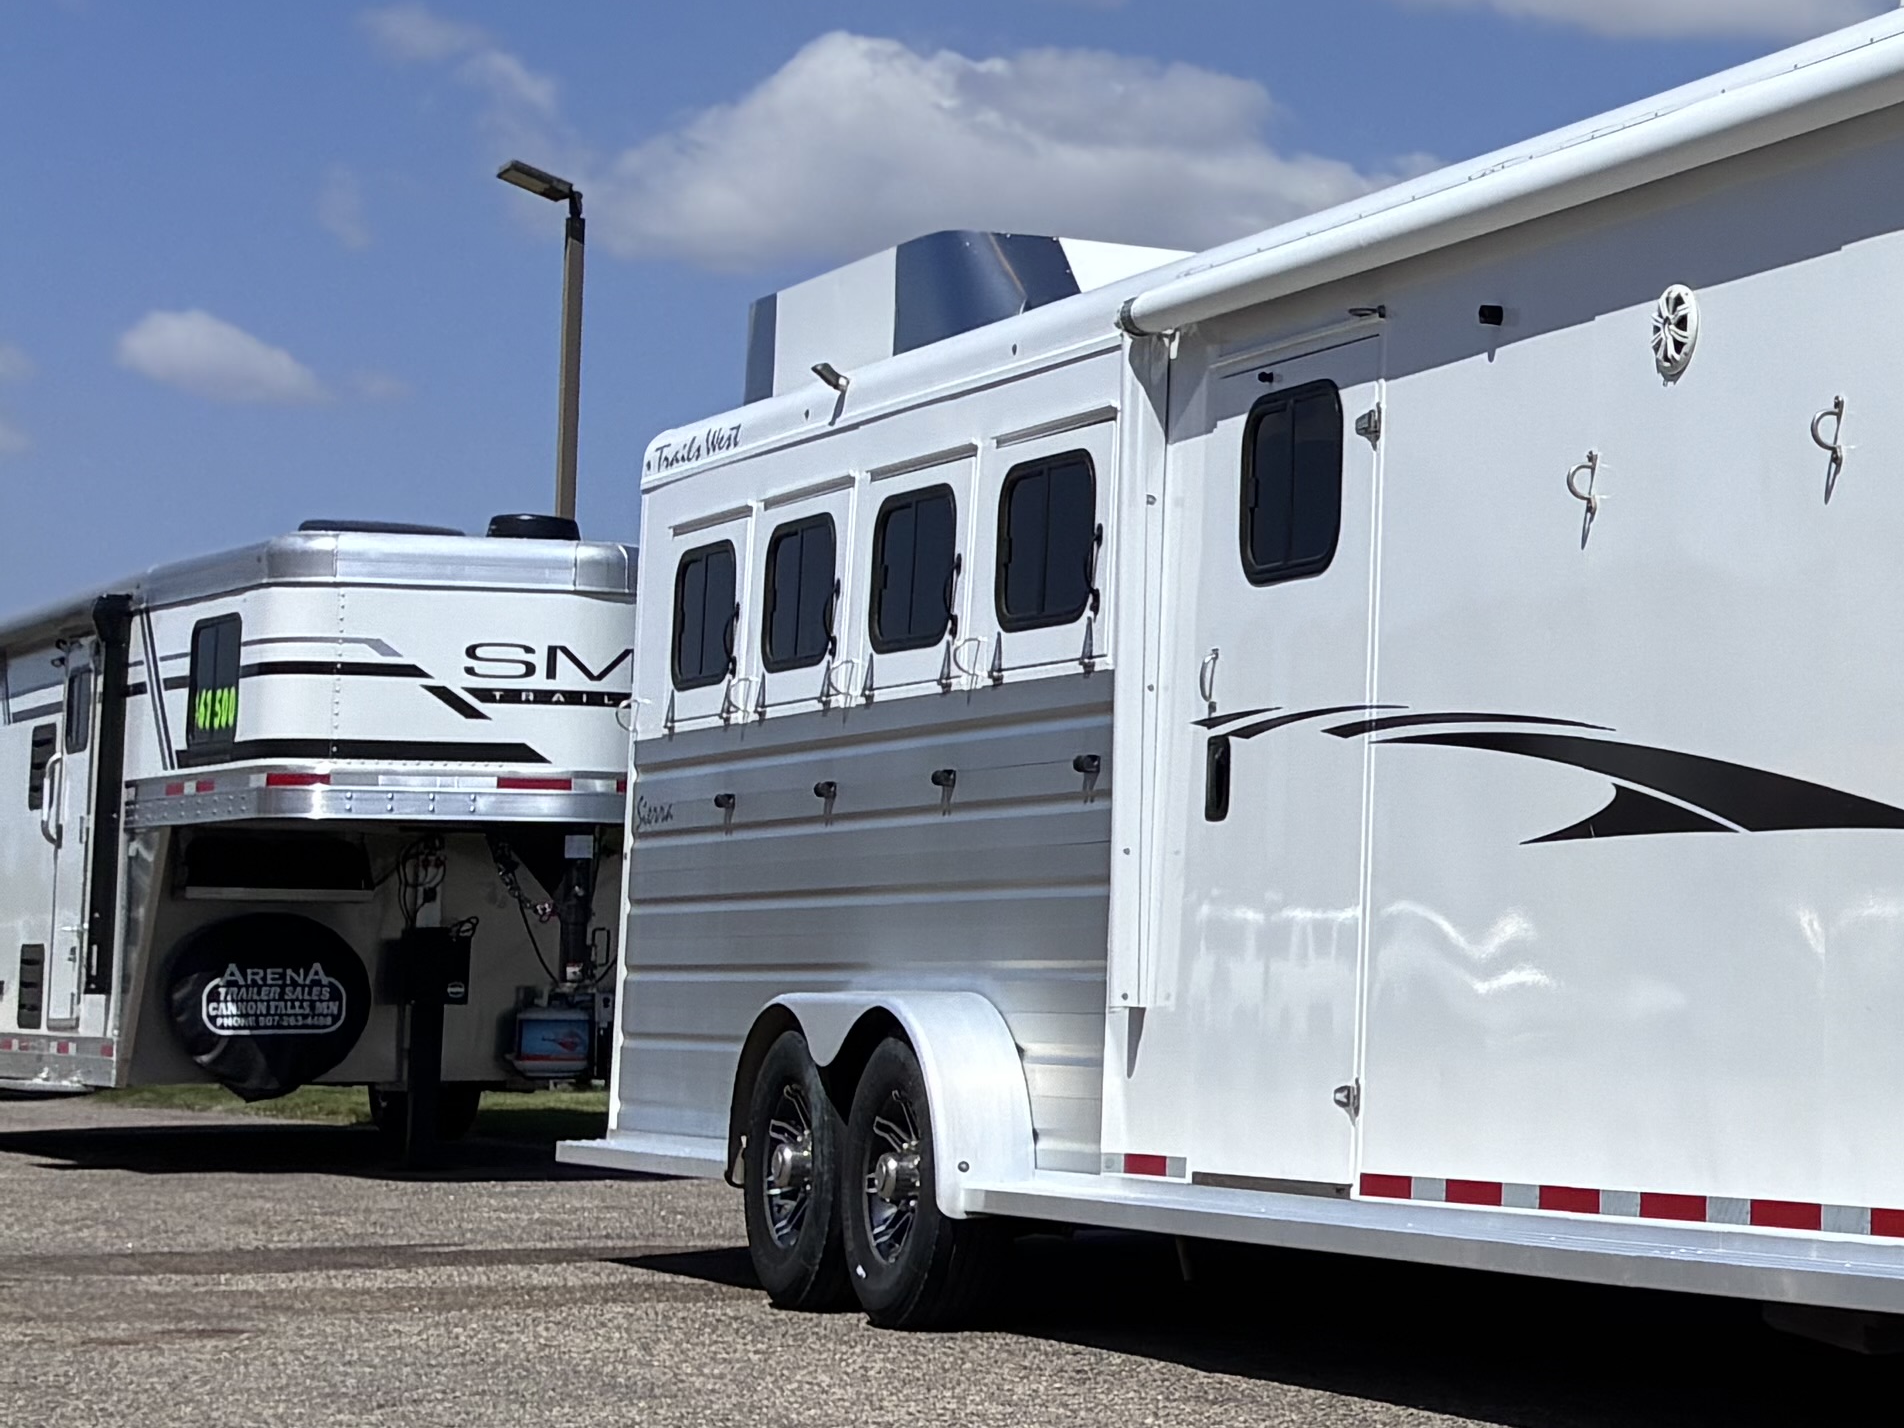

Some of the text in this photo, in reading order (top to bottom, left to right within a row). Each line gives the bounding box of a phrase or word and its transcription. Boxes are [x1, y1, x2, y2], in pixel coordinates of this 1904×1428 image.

[655, 423, 742, 472] Trails West
[492, 691, 614, 704] TRAIL
[636, 795, 673, 831] Sierra
[218, 962, 330, 985] ARENA
[218, 986, 331, 1001] TRAILER SALES
